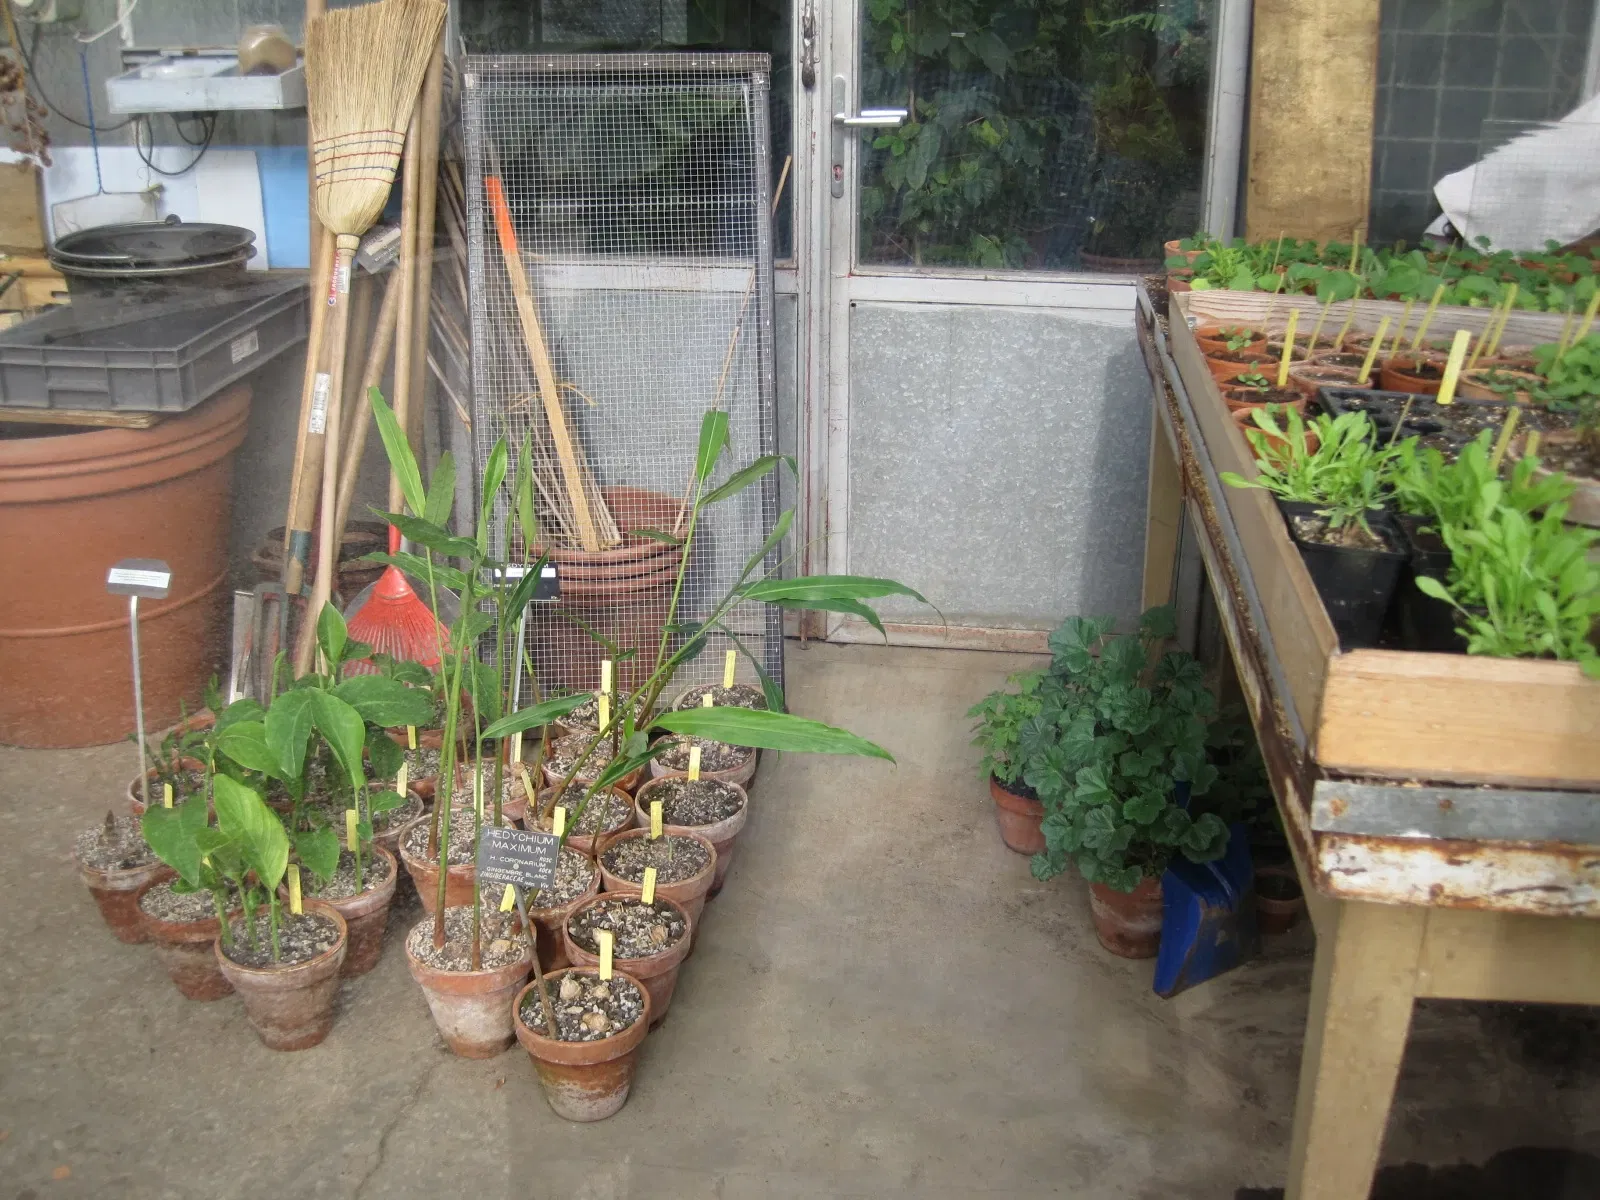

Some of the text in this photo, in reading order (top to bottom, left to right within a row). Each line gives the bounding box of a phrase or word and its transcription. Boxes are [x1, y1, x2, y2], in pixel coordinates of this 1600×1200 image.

[487, 828, 554, 846] HEDYCHIUM
[491, 840, 547, 855] MAXIMUM
[499, 856, 546, 868] CORONARIUM
[525, 872, 548, 880] BLANC
